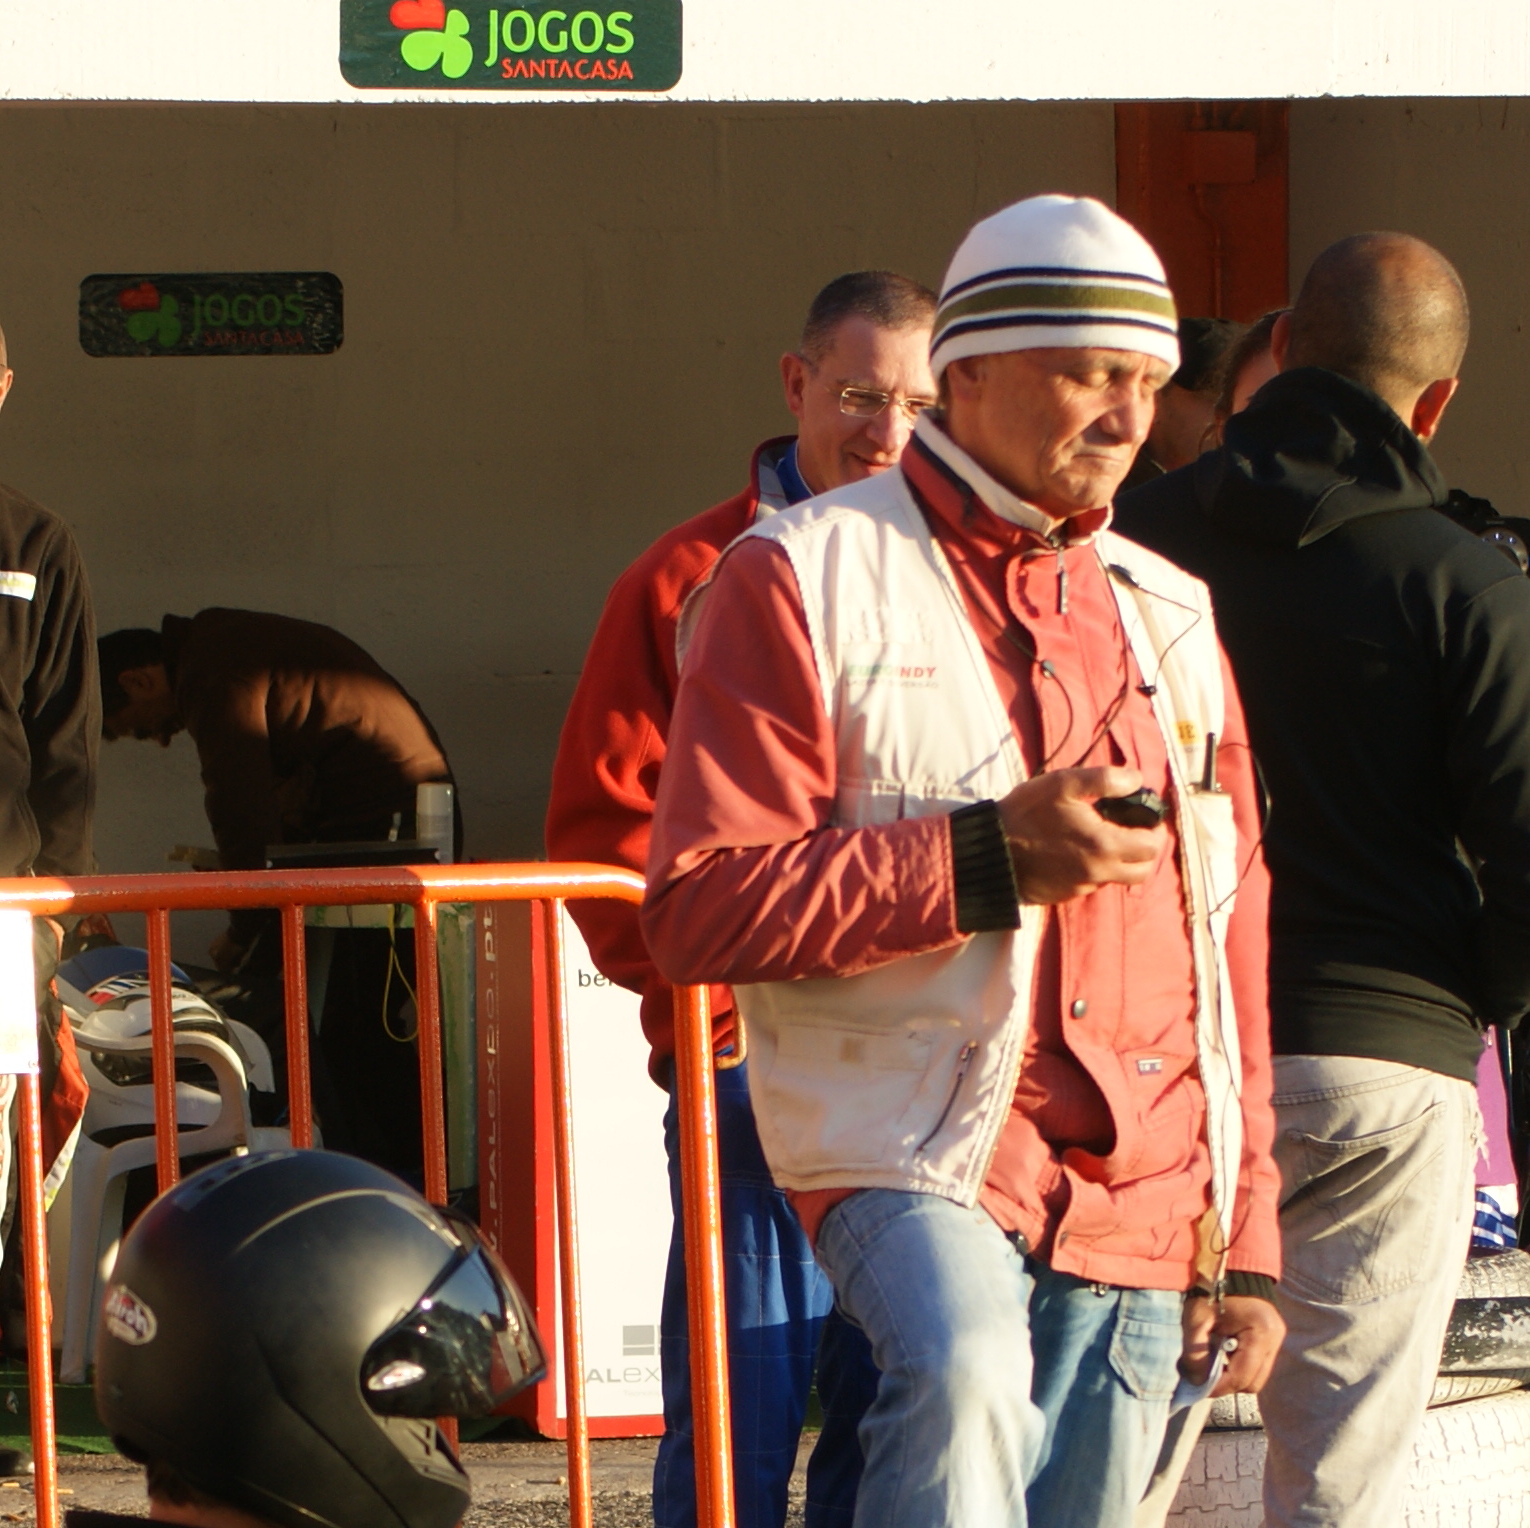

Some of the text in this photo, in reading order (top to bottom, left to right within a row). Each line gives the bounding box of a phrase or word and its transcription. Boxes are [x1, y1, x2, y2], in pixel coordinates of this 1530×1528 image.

[484, 9, 635, 68] JOGOS
[501, 58, 635, 80] SANTACASA
[191, 294, 305, 341] JOGOS
[205, 331, 305, 347] SANTACASA
